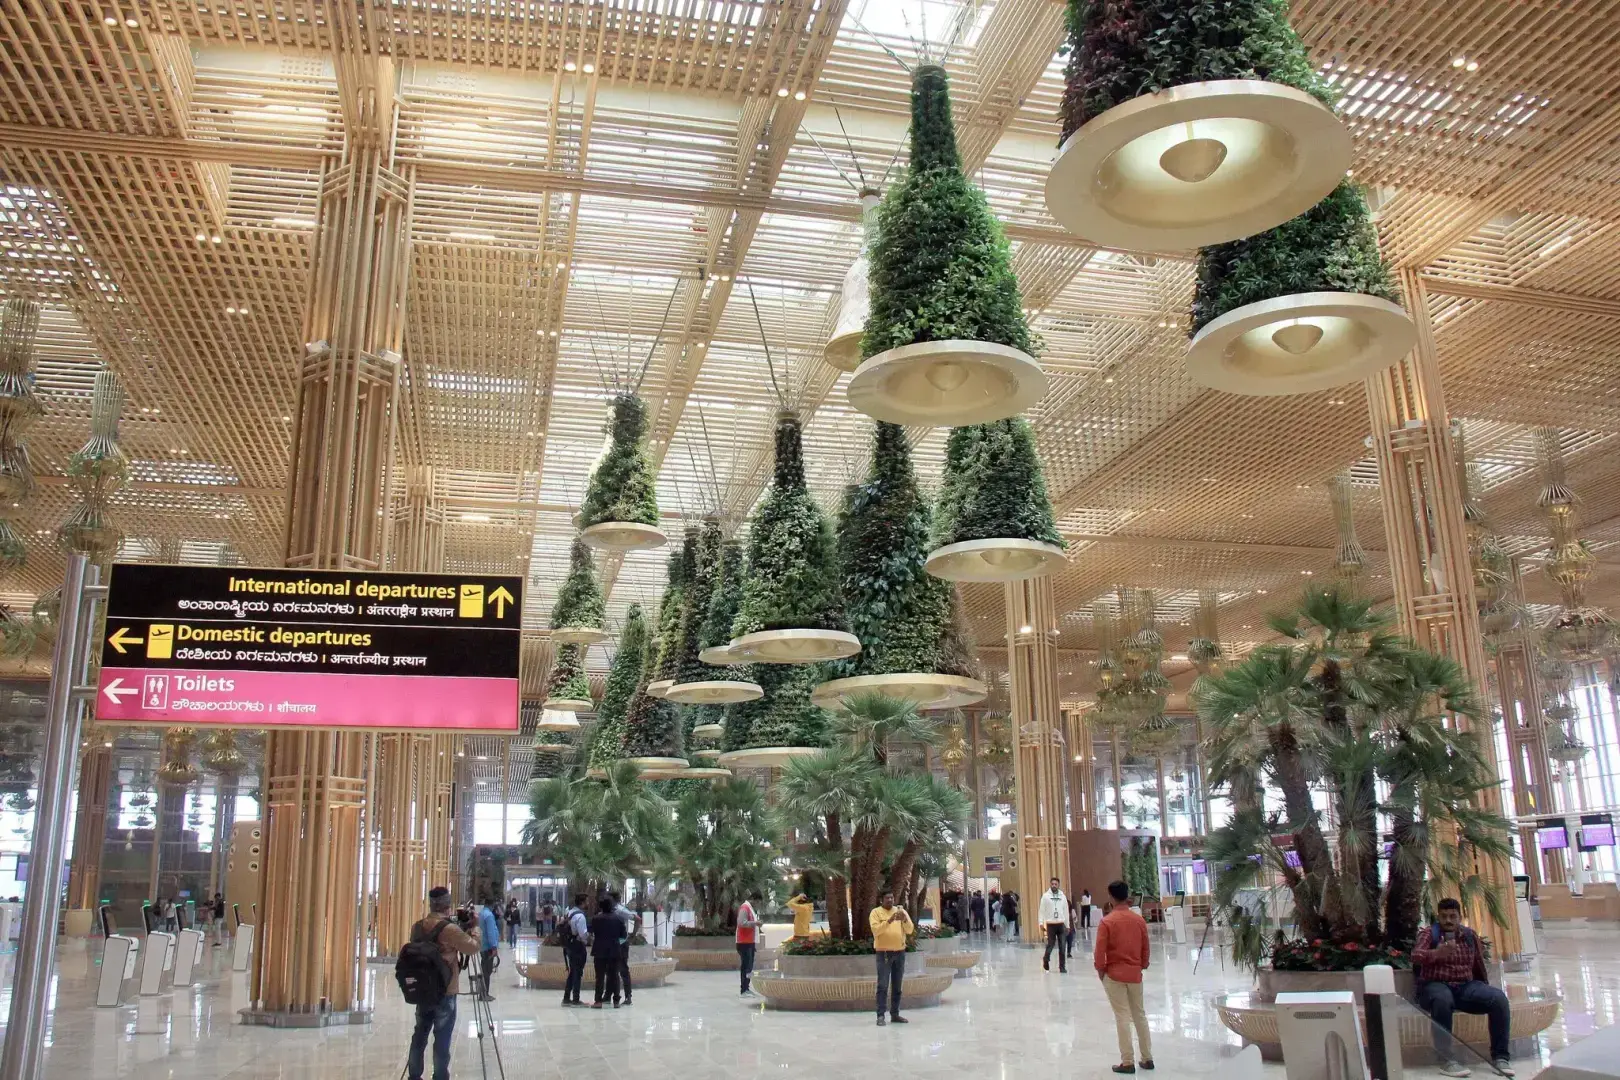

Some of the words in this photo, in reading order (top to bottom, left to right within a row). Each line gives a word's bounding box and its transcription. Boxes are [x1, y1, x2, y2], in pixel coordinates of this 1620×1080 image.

[229, 577, 350, 596] International
[355, 581, 456, 600] departures
[272, 601, 354, 614] ನಿರ್ಗಮನಗಳು
[421, 607, 455, 617] प्रस्थान
[177, 625, 265, 643] Domestic
[269, 627, 372, 647] departures
[235, 649, 318, 663] ನಿರ್ಗಮನಗಳು
[330, 652, 389, 666] अन्तर्राज्यीय
[392, 656, 427, 666] प्रस्थान
[174, 675, 235, 692] Toilets
[277, 701, 317, 713] शौचालय
